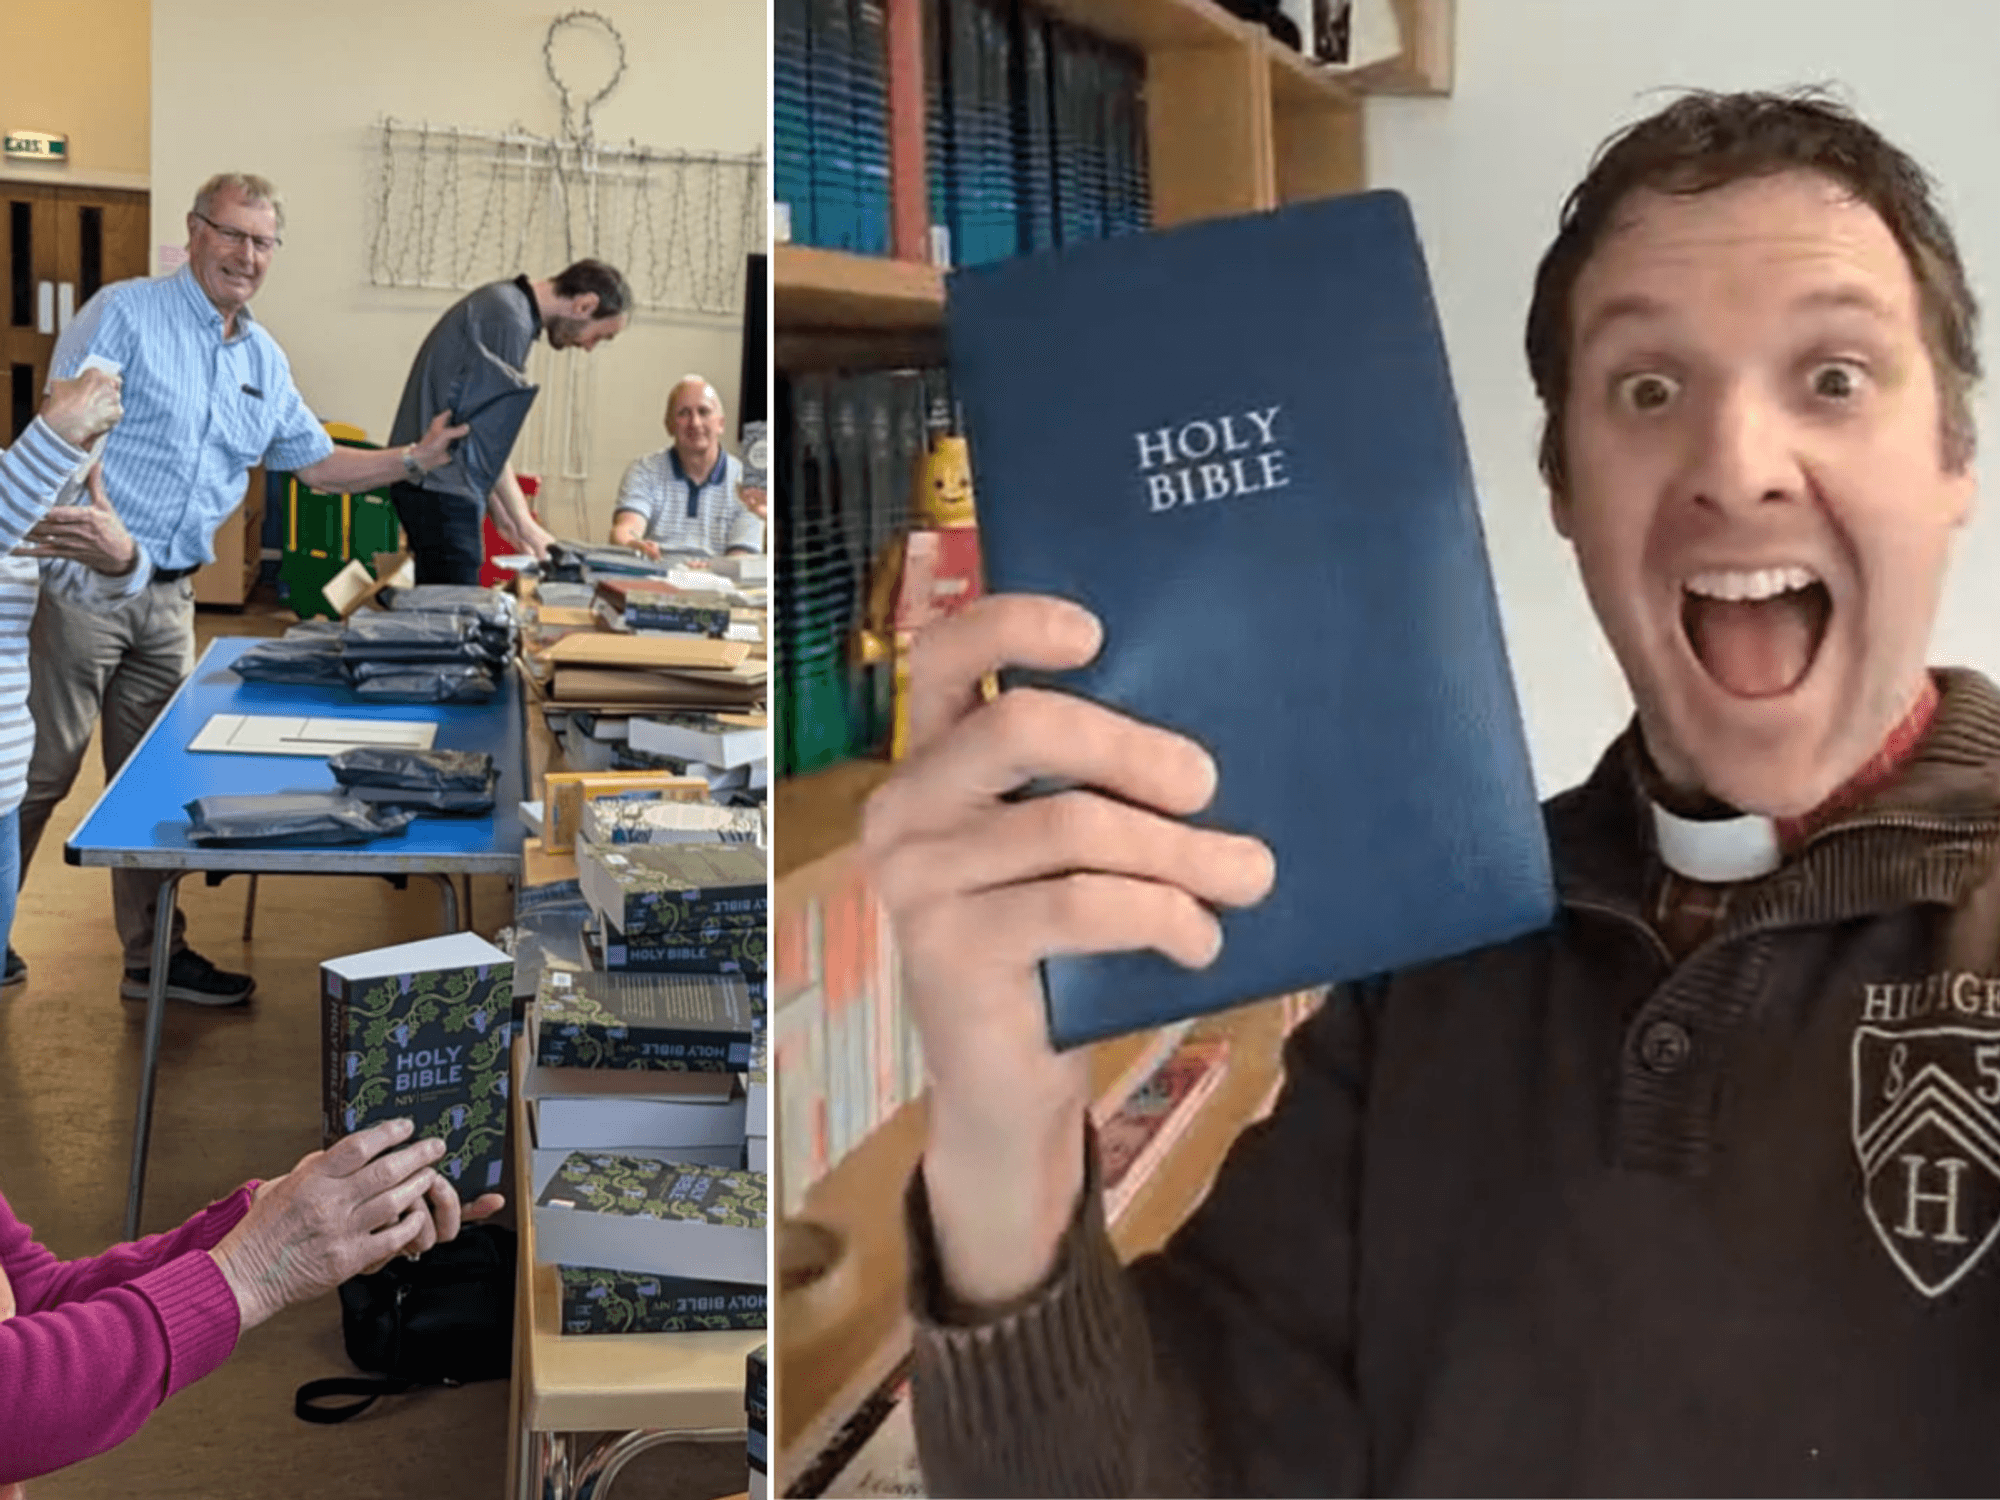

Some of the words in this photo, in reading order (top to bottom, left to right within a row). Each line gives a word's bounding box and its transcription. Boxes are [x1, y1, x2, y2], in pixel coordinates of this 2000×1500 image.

[1134, 405, 1281, 470] HOLY
[1147, 449, 1291, 513] BIBLE
[630, 947, 666, 961] HOLY
[667, 947, 708, 960] BIBLE
[397, 1045, 463, 1072] HOLY
[640, 1043, 685, 1057] BIBLE
[687, 1044, 726, 1058] HOLY
[395, 1065, 463, 1092] BIBLE
[1884, 1042, 1908, 1101] 8
[1974, 1044, 2000, 1106] 5
[1895, 1154, 1968, 1243] H
[677, 1297, 725, 1313] BIBLE
